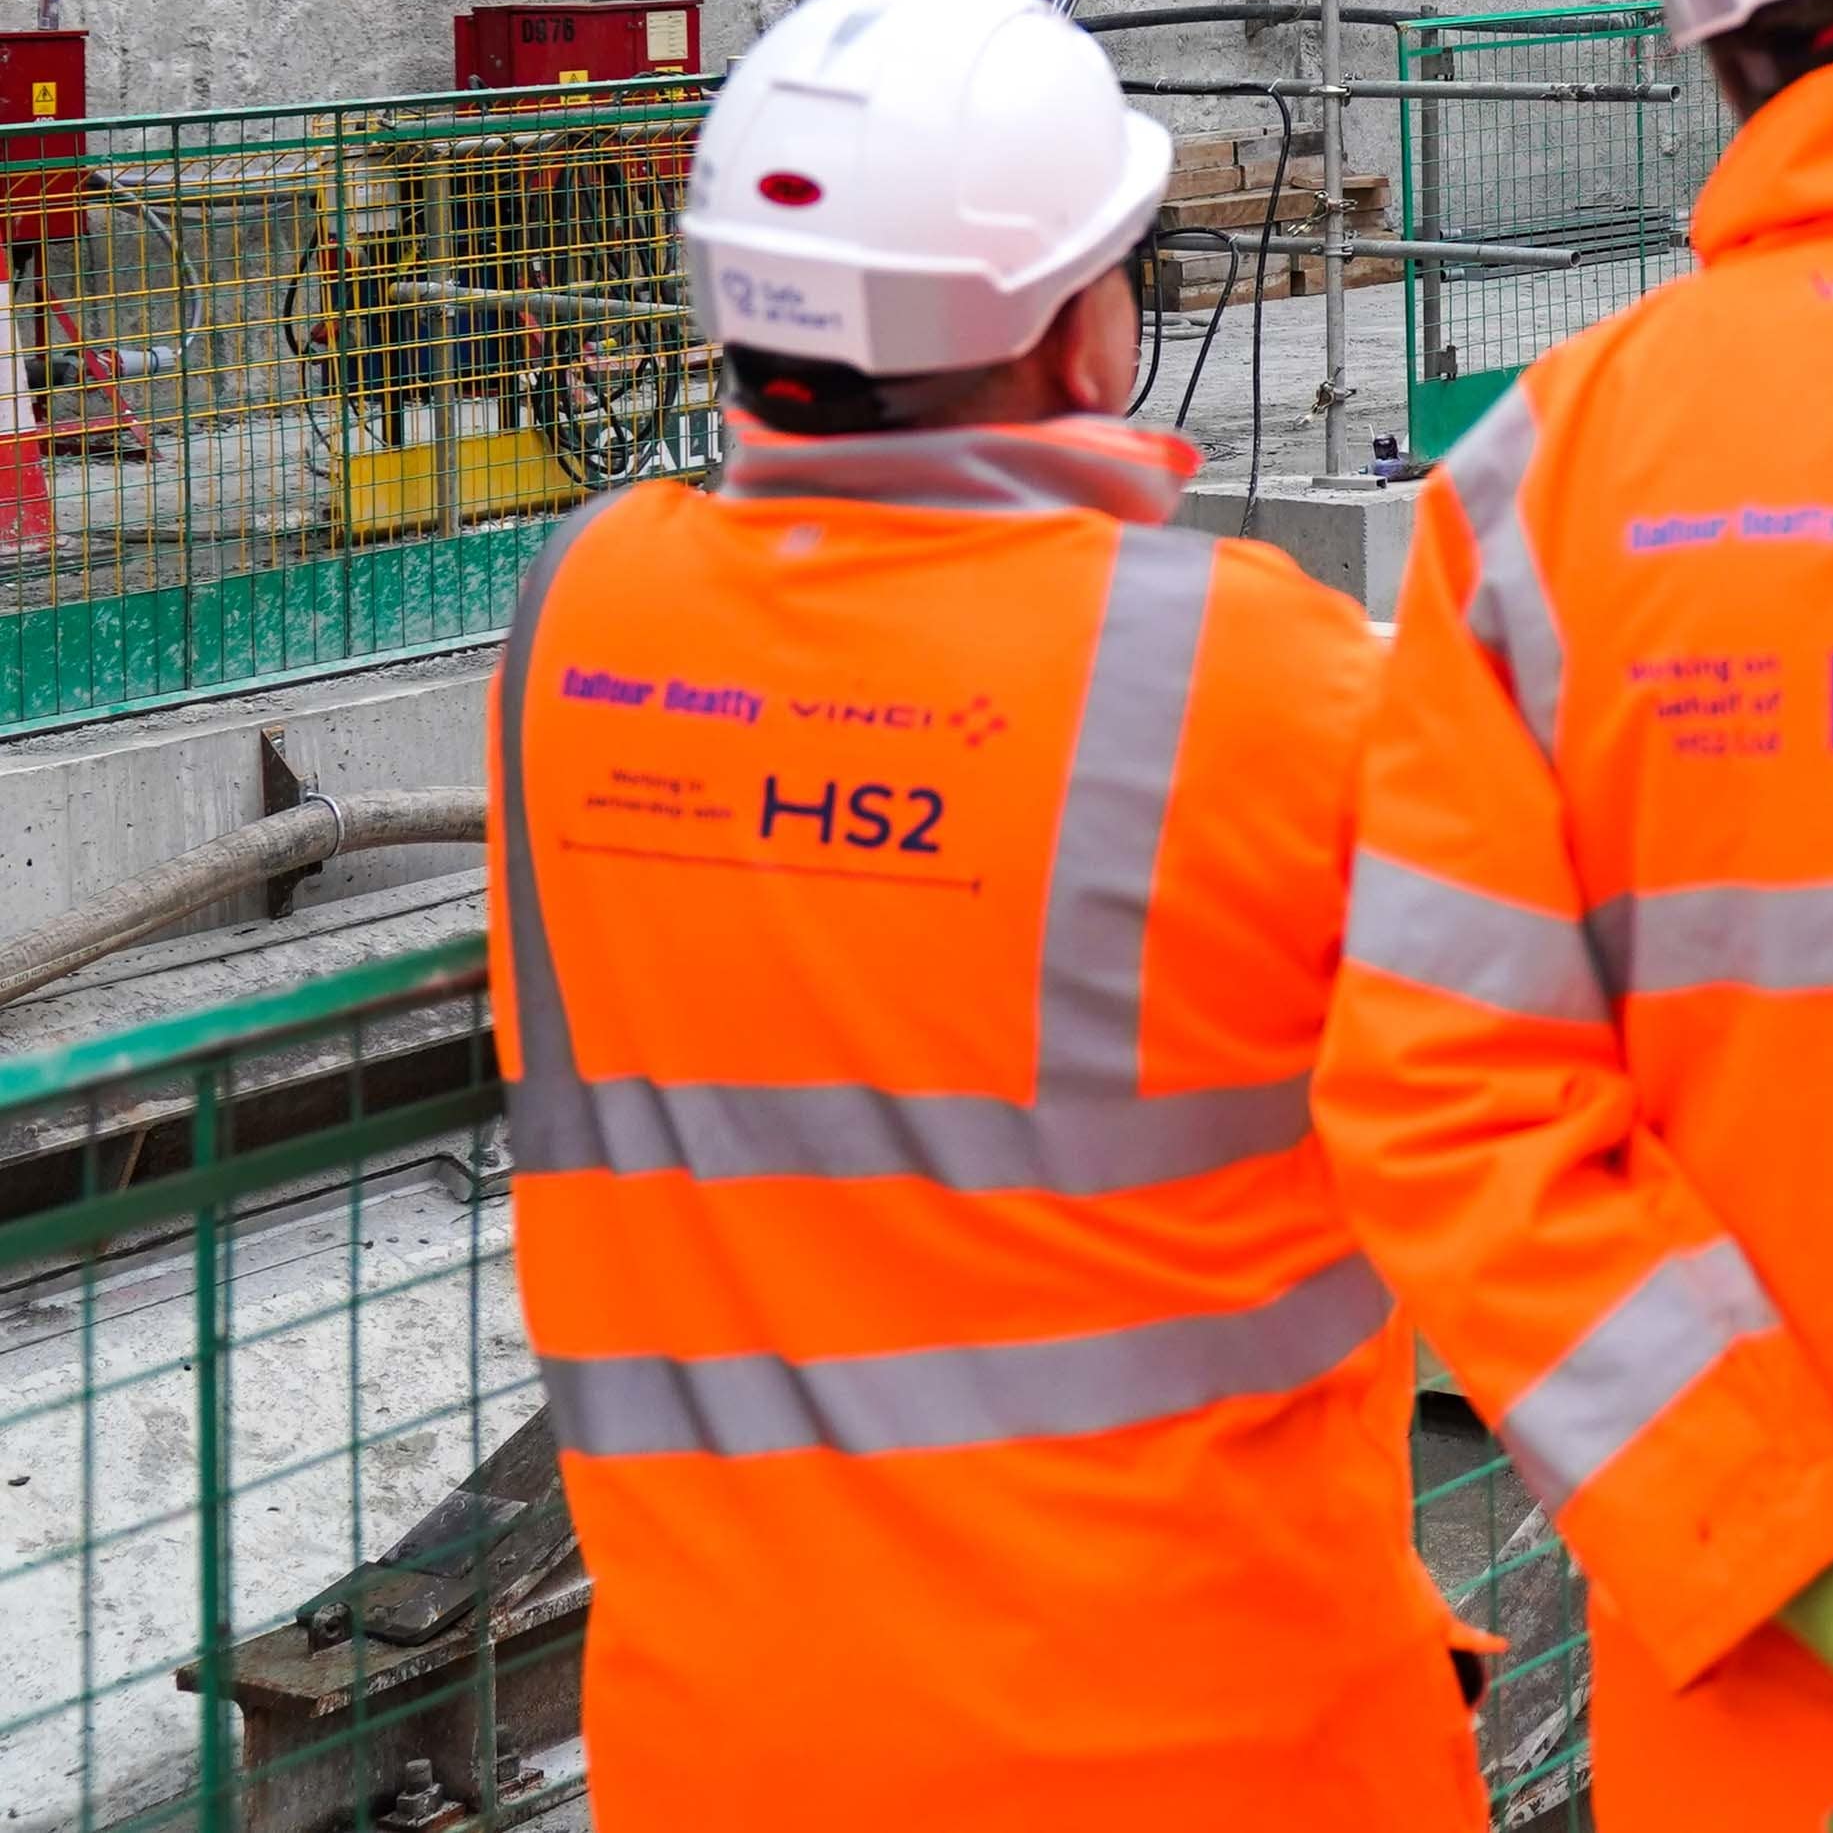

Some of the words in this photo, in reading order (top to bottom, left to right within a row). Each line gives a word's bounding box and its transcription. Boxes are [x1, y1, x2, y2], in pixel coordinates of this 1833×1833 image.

[664, 681, 764, 726] Beatty
[789, 699, 936, 730] VINCI
[758, 775, 944, 854] HS2
